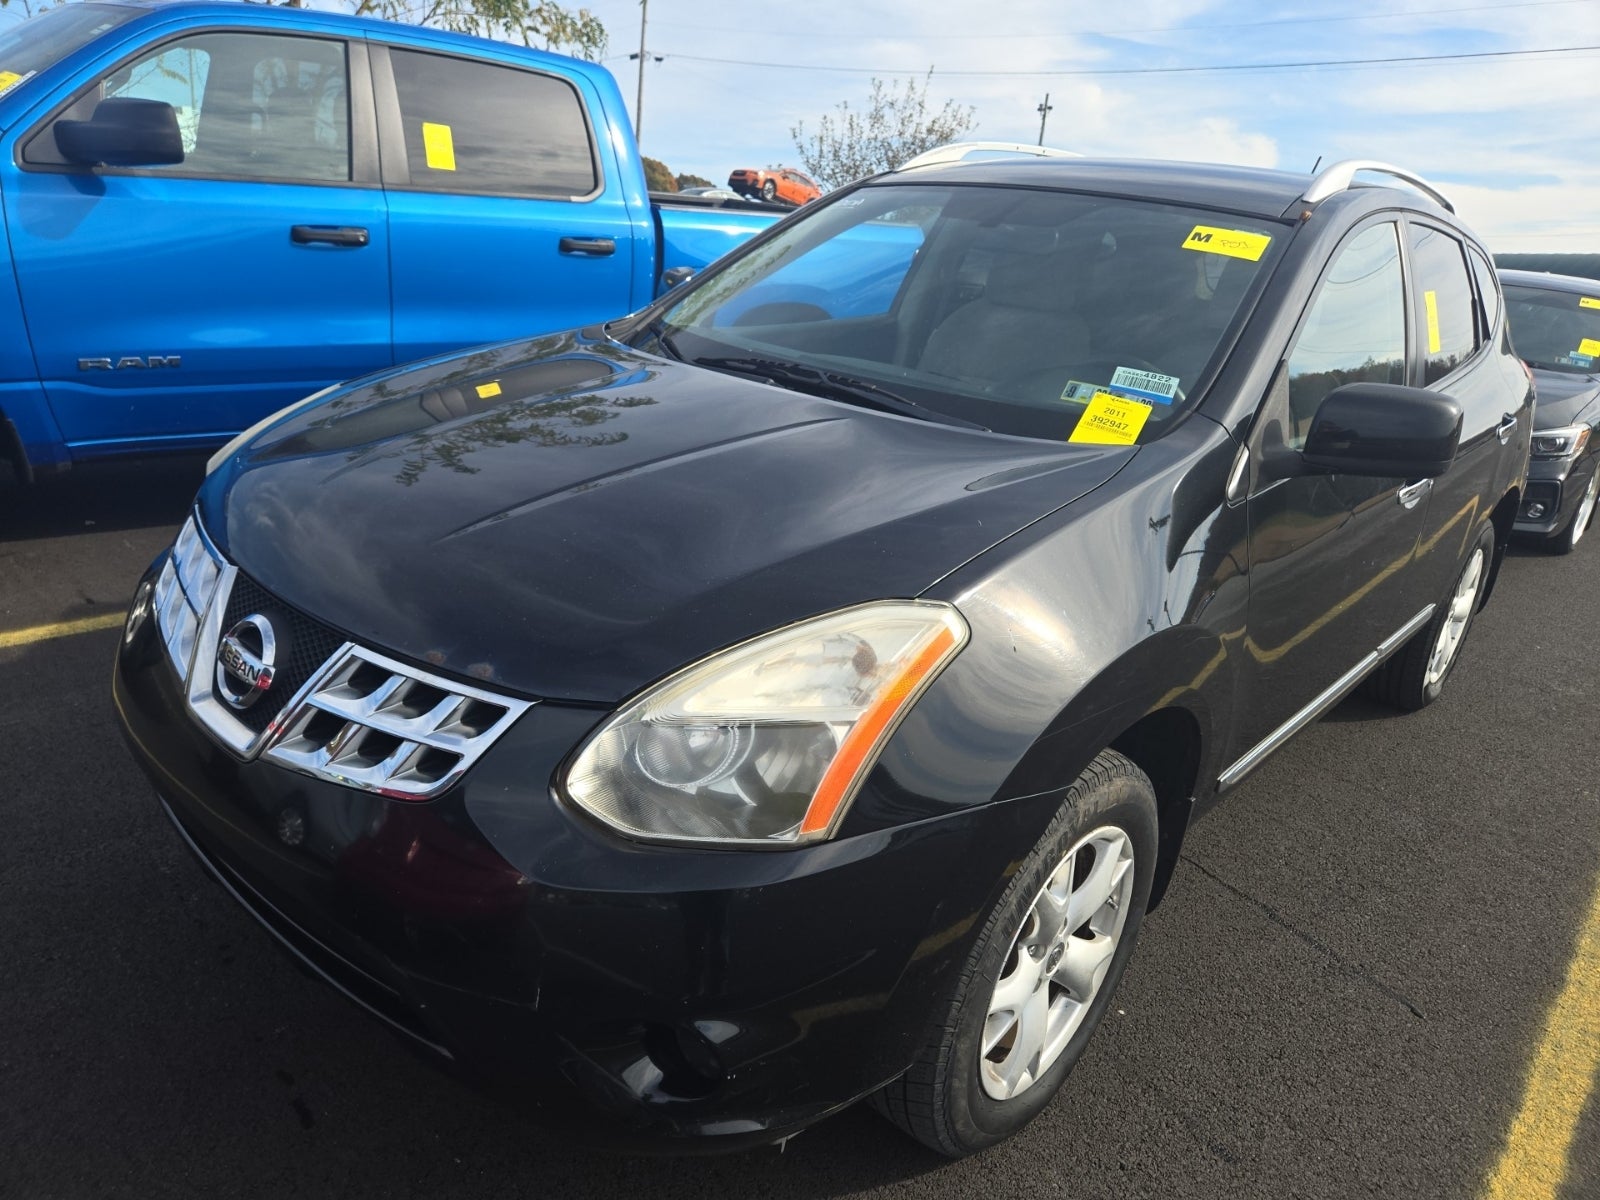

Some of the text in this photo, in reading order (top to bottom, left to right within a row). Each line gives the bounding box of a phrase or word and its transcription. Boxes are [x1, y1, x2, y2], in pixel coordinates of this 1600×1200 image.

[79, 356, 181, 370] RAM
[1103, 407, 1127, 418] 2011
[1090, 415, 1129, 431] 392947
